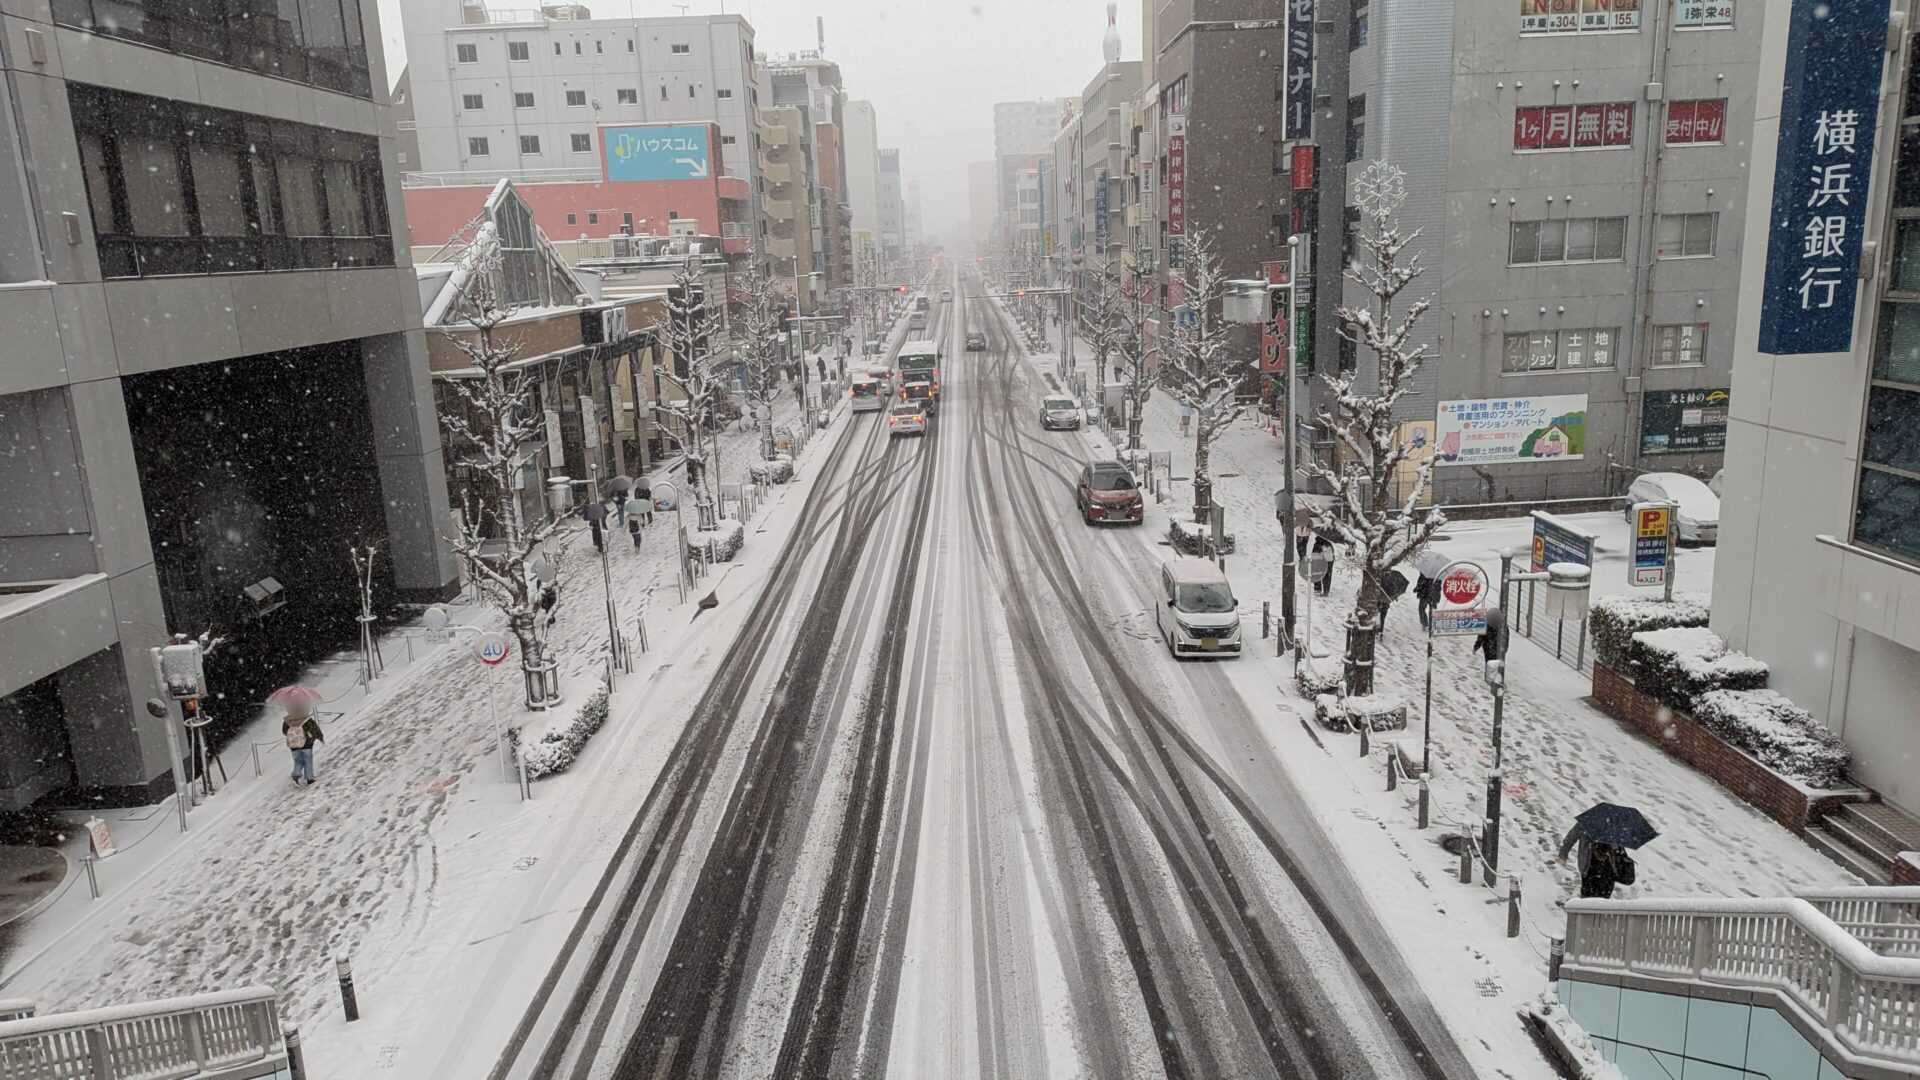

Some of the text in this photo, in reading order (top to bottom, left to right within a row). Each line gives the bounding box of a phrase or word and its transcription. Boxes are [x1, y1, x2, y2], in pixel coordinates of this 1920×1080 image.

[636, 138, 698, 152] ハウスコム
[1799, 109, 1859, 310] 横浜銀行
[1508, 334, 1552, 349] アパート
[1567, 332, 1609, 347] 土地
[1661, 338, 1693, 349] 仲介
[1509, 353, 1556, 367] マンション
[1567, 351, 1608, 365] 建物
[1642, 511, 1660, 529] P
[1534, 537, 1543, 556] P
[1637, 540, 1666, 548] 横浜銀行
[1445, 579, 1478, 596] 消火栓
[1644, 576, 1656, 584] 入口
[483, 641, 502, 657] 40
